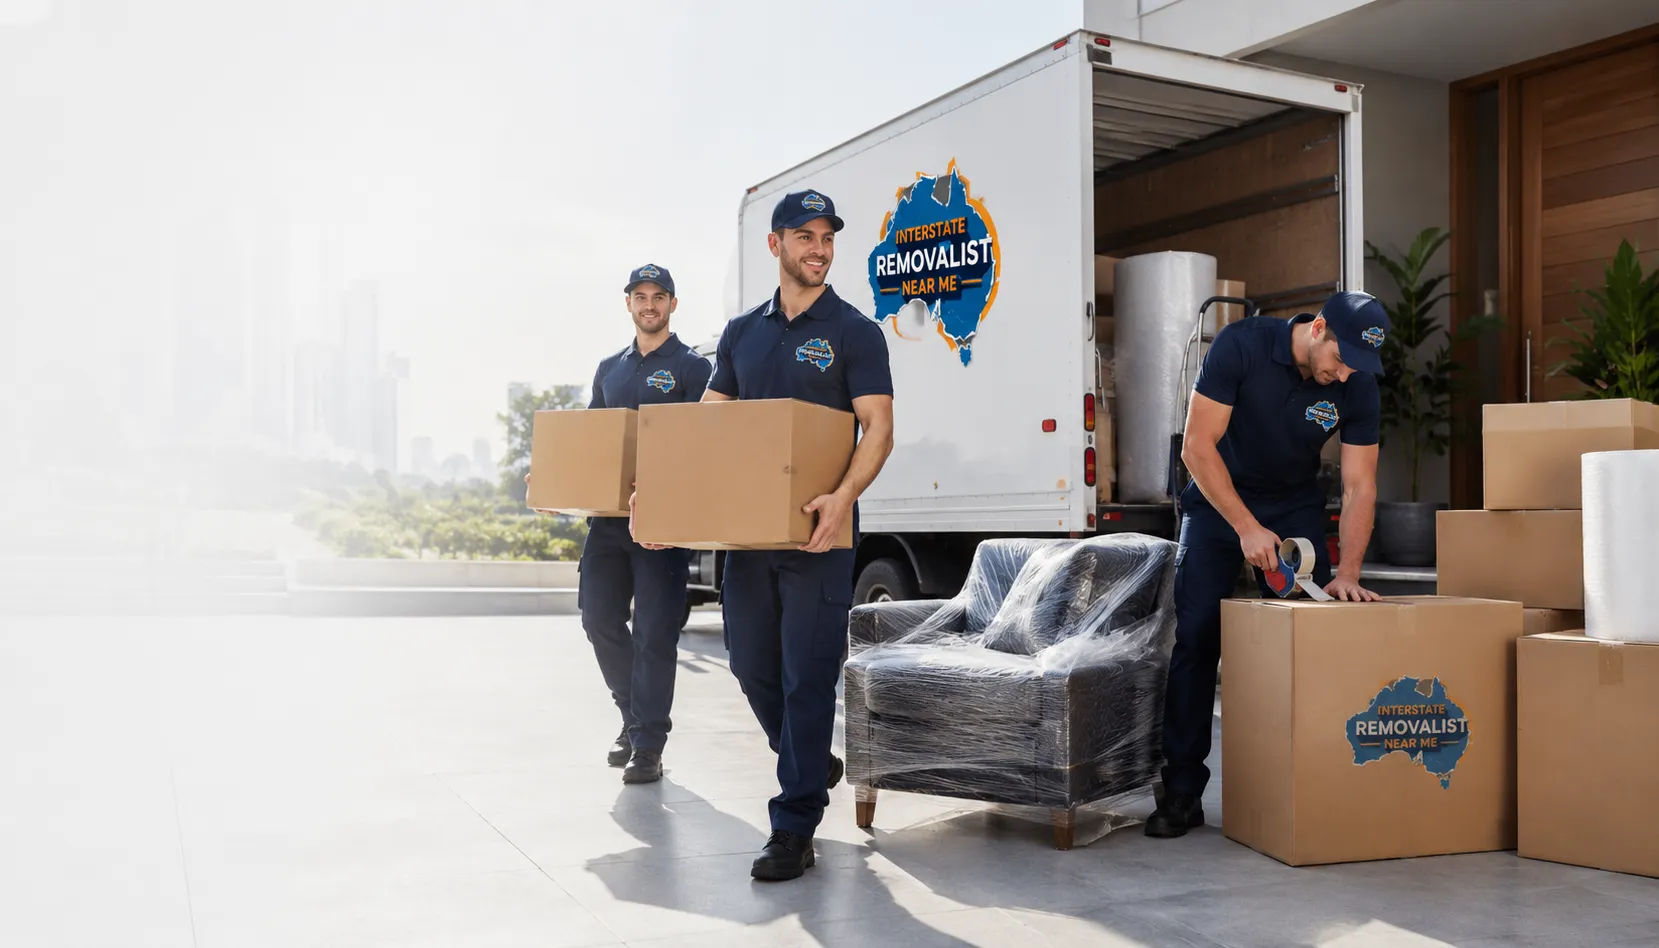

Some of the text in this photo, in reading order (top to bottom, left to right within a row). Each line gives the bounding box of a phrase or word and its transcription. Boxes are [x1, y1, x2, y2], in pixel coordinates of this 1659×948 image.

[896, 217, 966, 244] INTERSTATE
[876, 237, 993, 276] REMOVALIST
[902, 275, 957, 295] NEAR ME
[1378, 704, 1445, 715] INTERSTATE
[1356, 719, 1468, 735] REMOVALIST
[1384, 738, 1438, 748] NEAR ME
